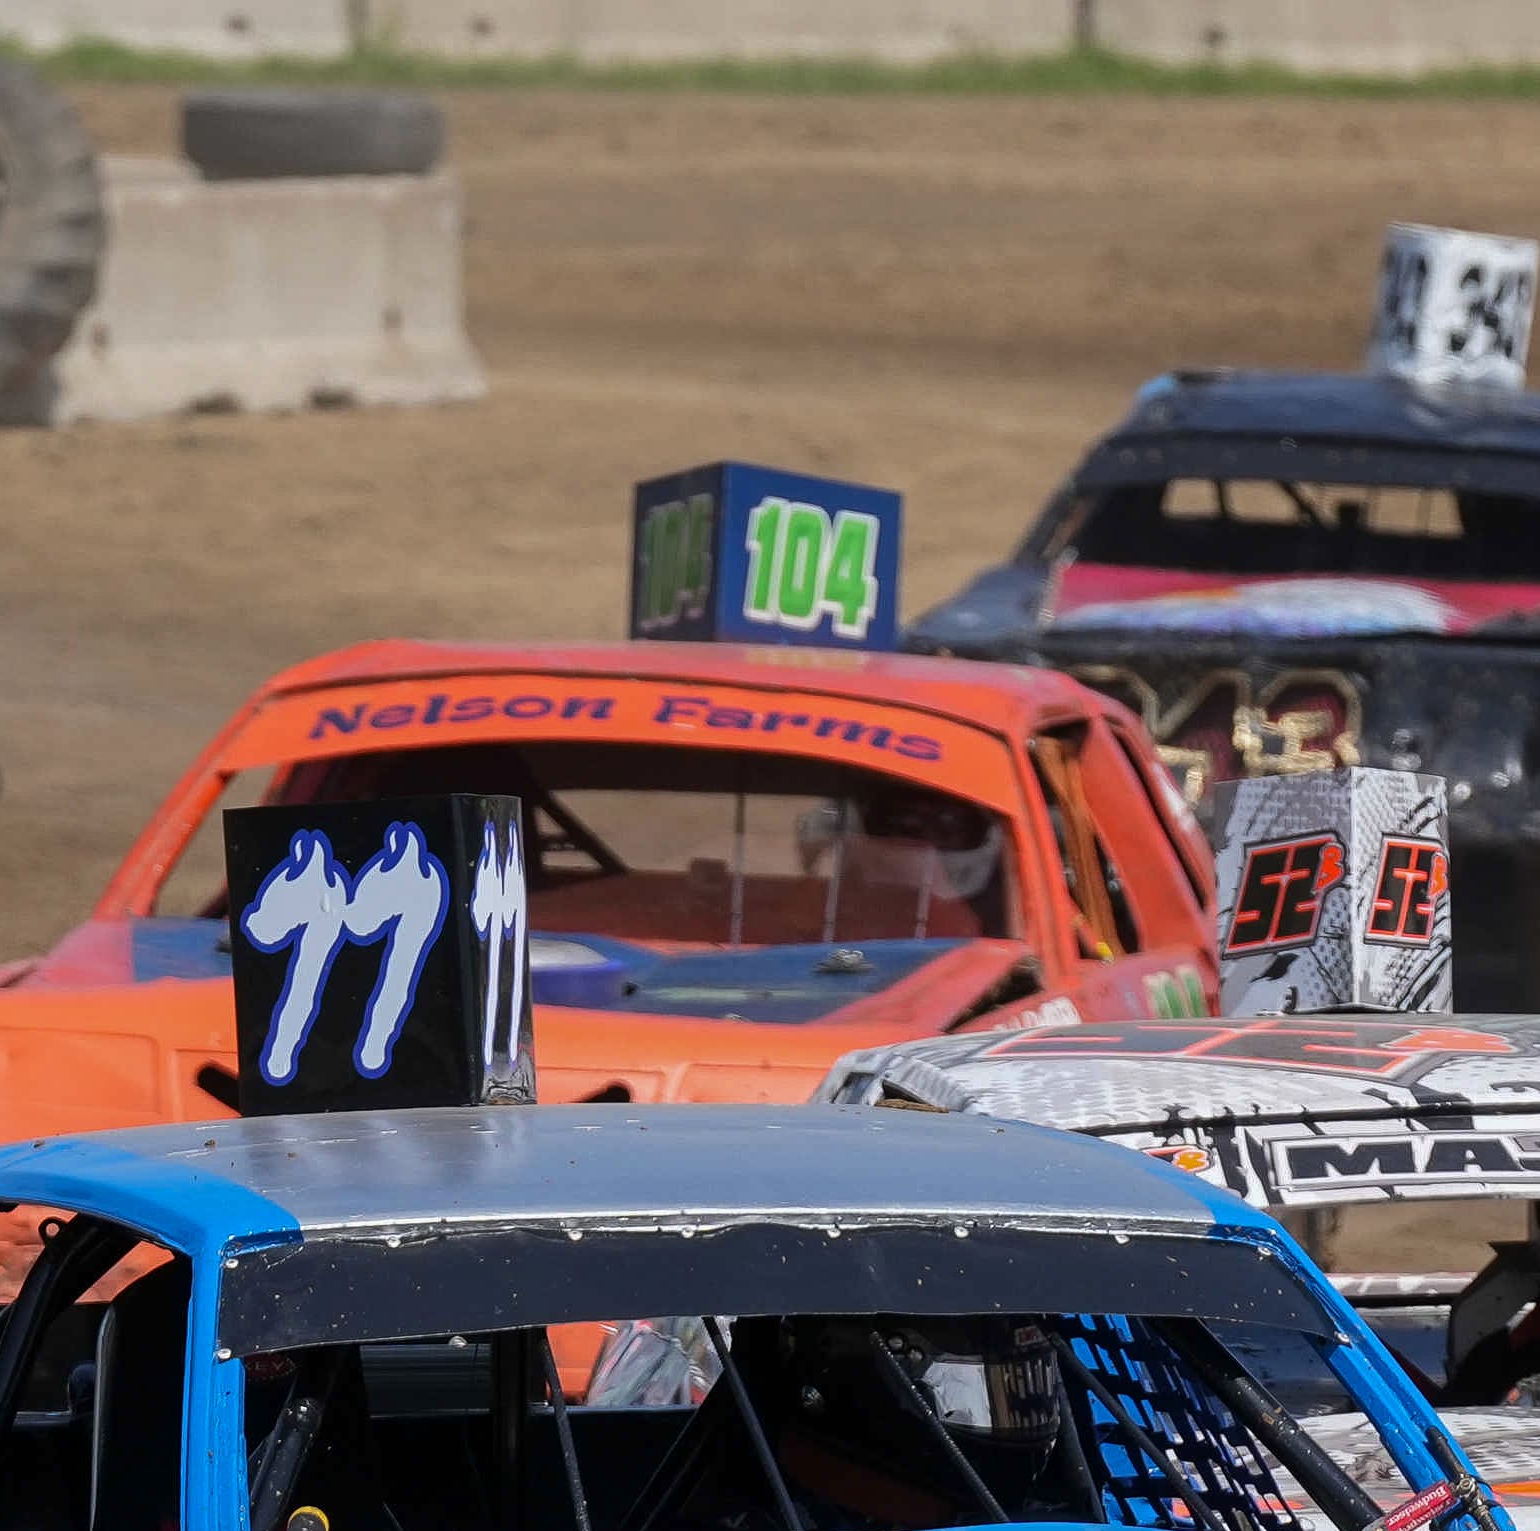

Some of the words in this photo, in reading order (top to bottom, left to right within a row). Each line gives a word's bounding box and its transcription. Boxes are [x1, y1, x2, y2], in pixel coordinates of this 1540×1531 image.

[743, 496, 879, 639] 104
[307, 693, 614, 741] Nelson
[652, 694, 944, 762] Farms
[1388, 1486, 1448, 1527] Budweiser
